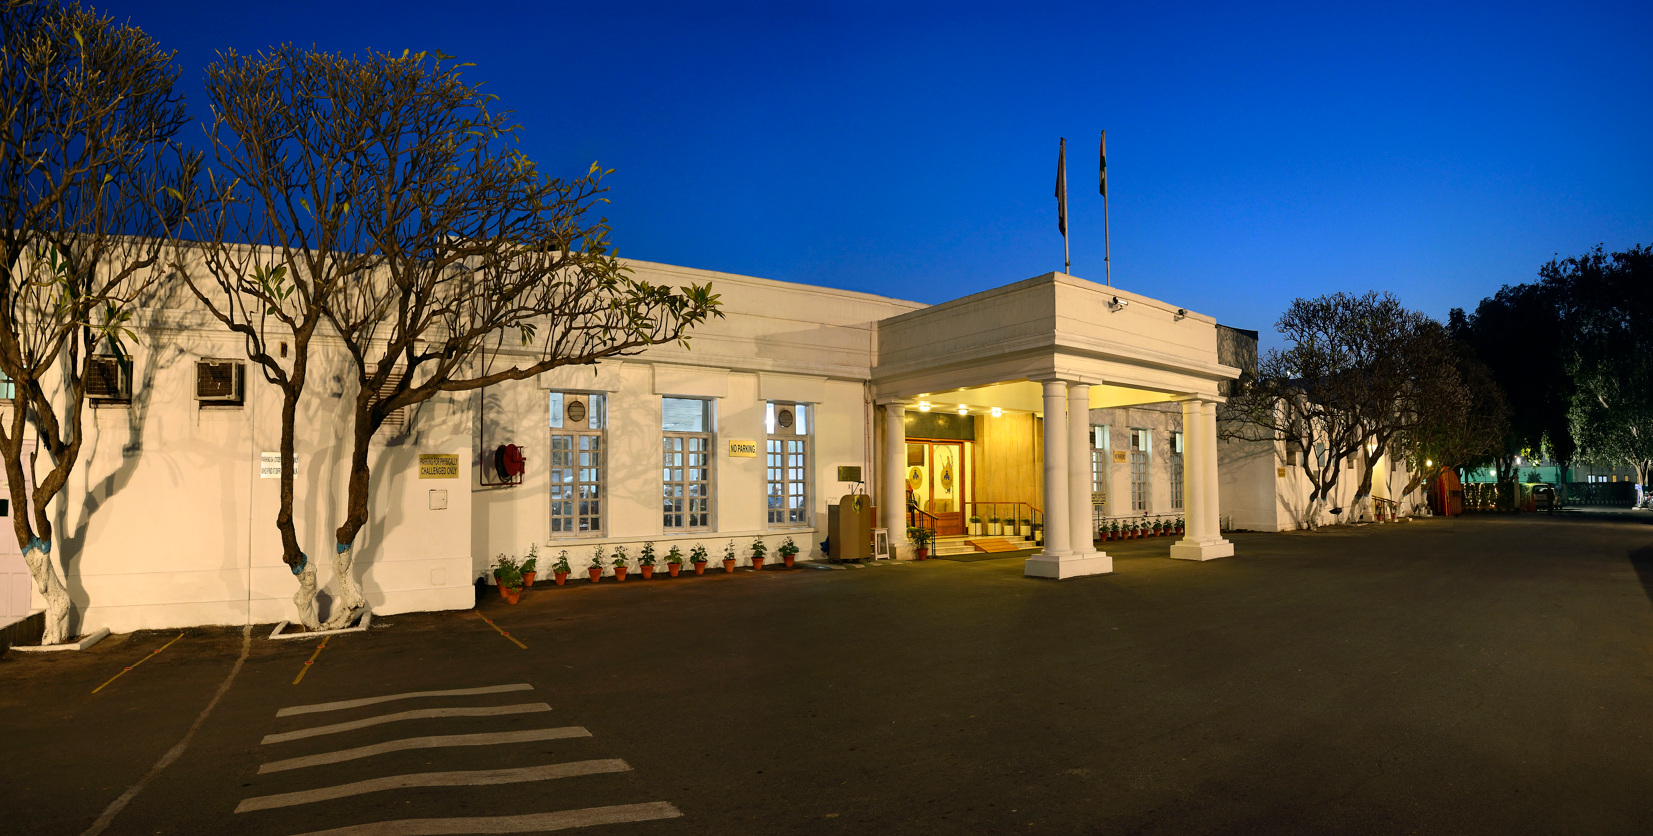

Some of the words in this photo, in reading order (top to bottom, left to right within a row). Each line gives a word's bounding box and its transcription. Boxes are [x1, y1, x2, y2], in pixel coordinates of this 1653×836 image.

[731, 444, 737, 452] NO
[738, 444, 755, 453] PARKING
[421, 467, 446, 475] CHALLENGED
[447, 467, 457, 475] ONLY
